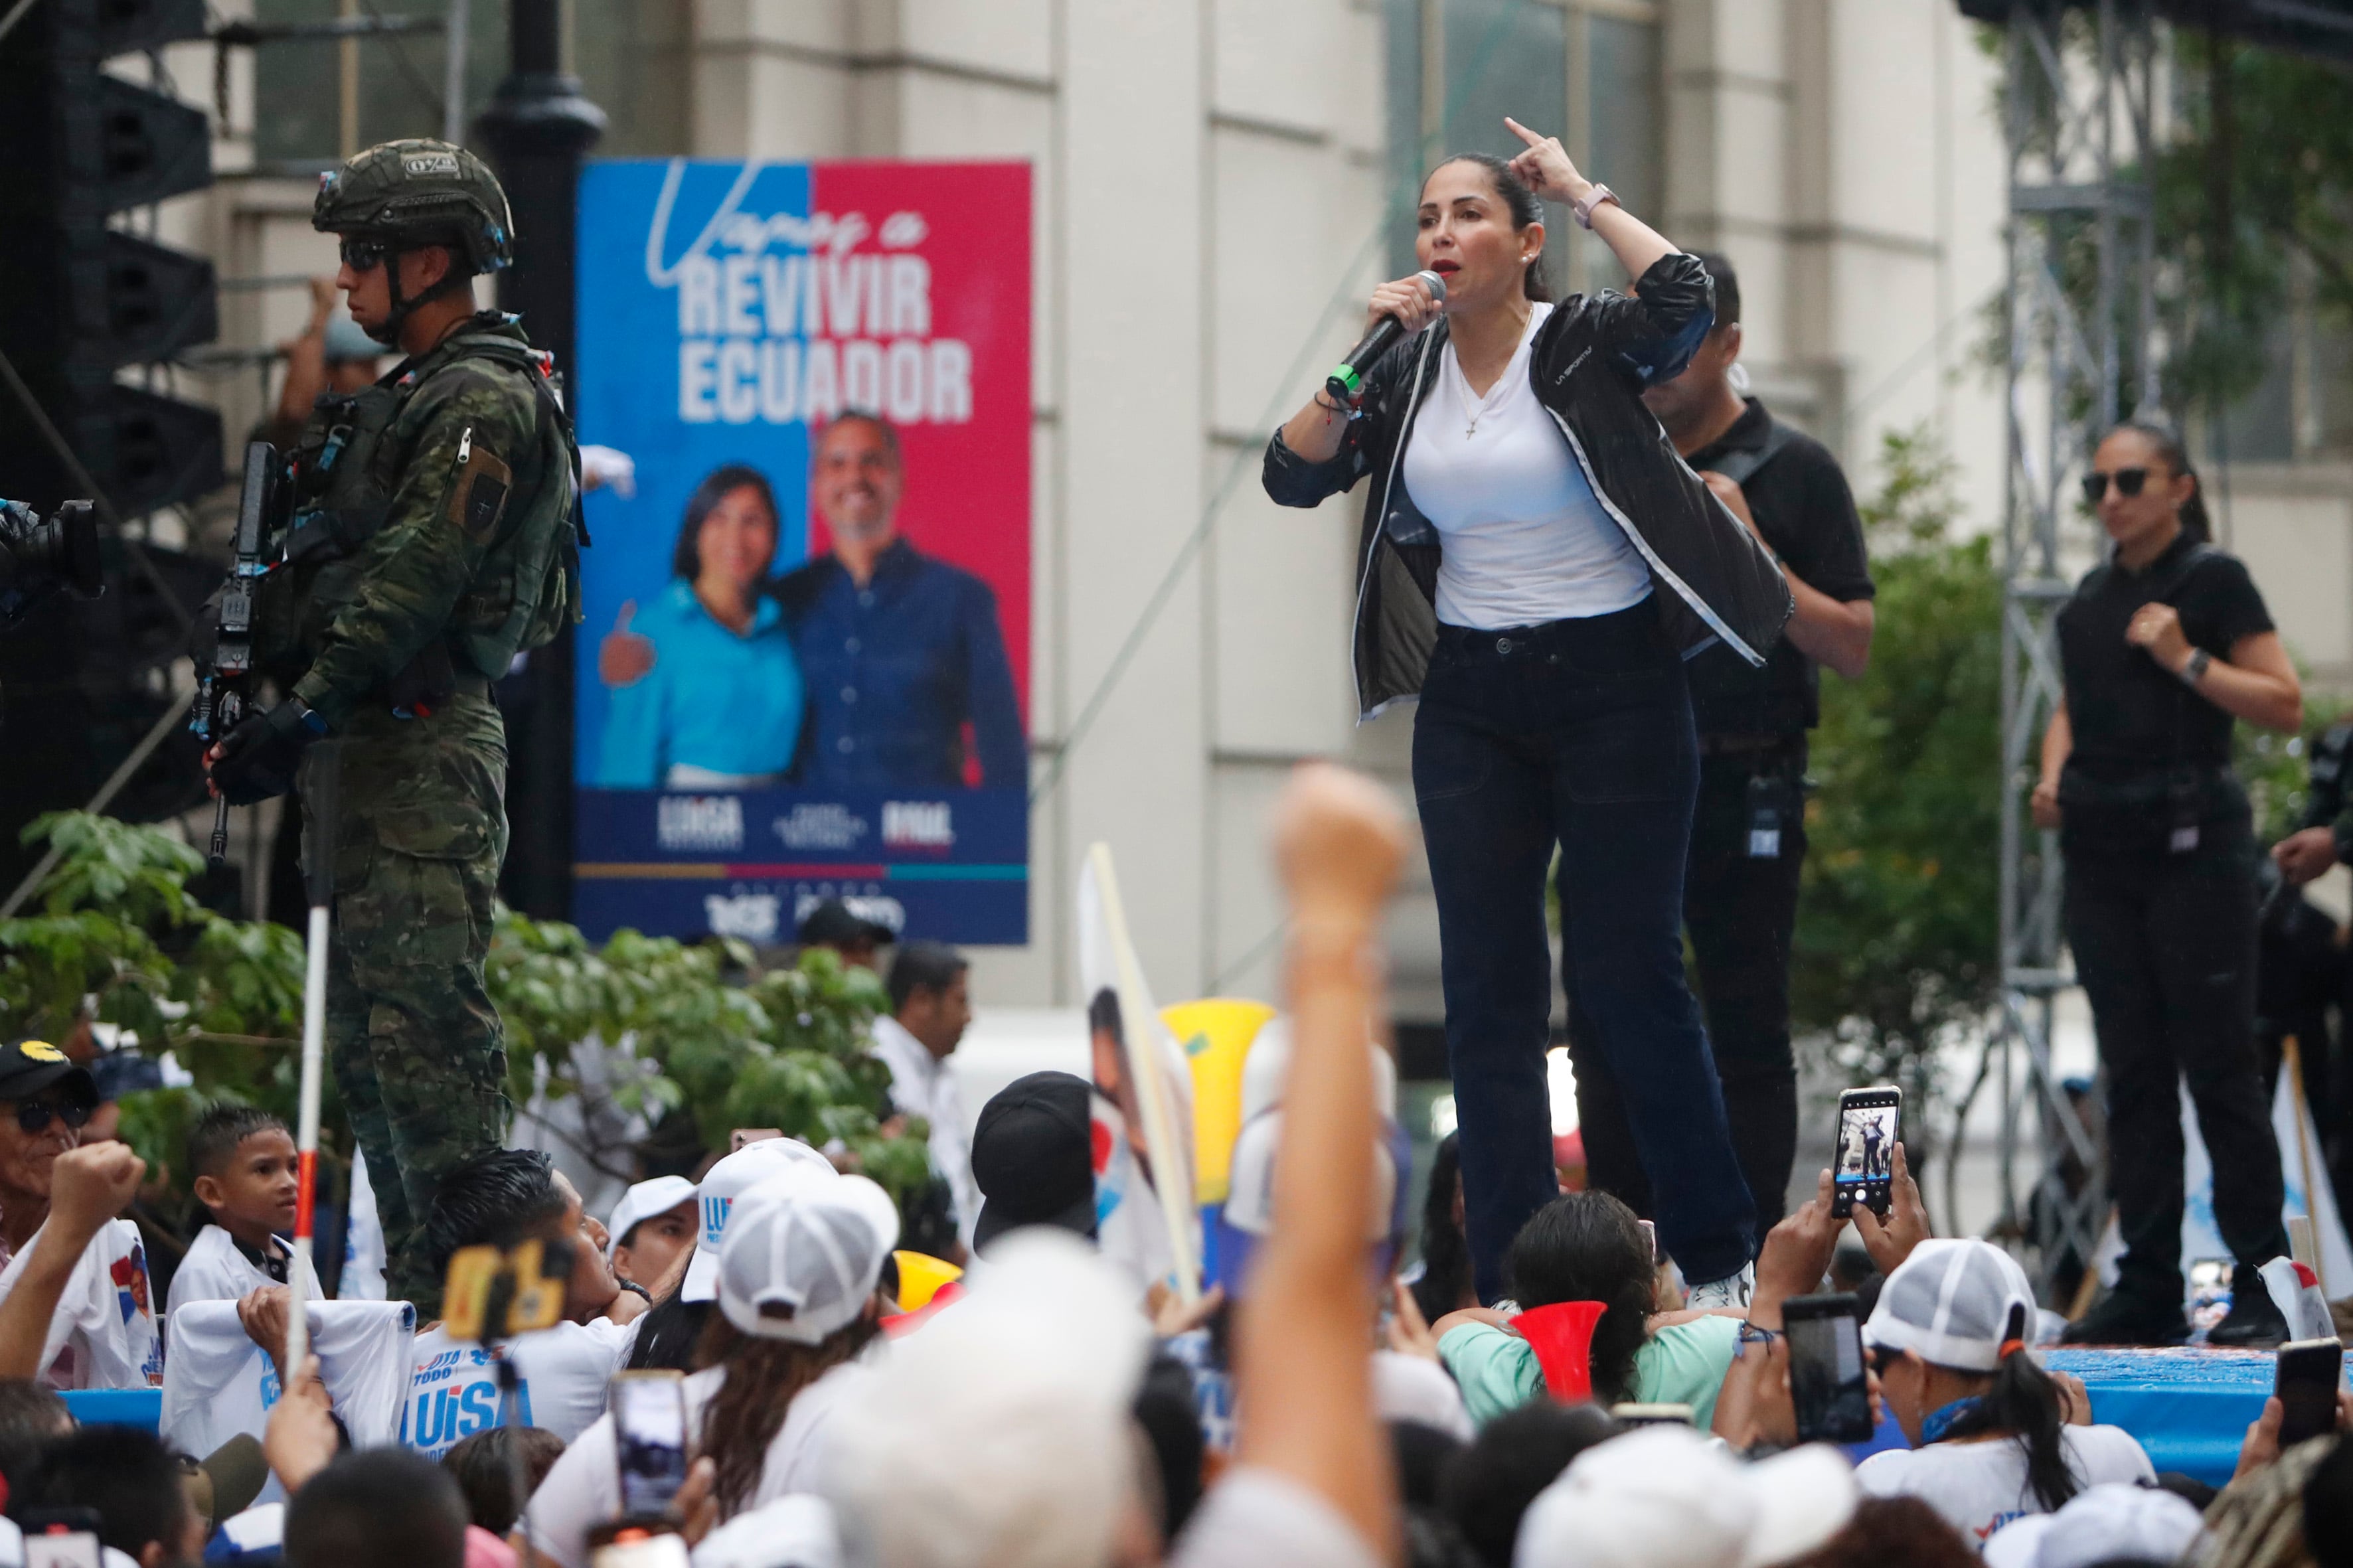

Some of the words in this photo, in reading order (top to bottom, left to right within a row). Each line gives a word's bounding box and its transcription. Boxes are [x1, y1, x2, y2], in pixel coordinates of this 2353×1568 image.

[679, 253, 931, 335] REVIVIR
[679, 337, 974, 425] ECUADOR
[414, 1366, 451, 1387] TODO
